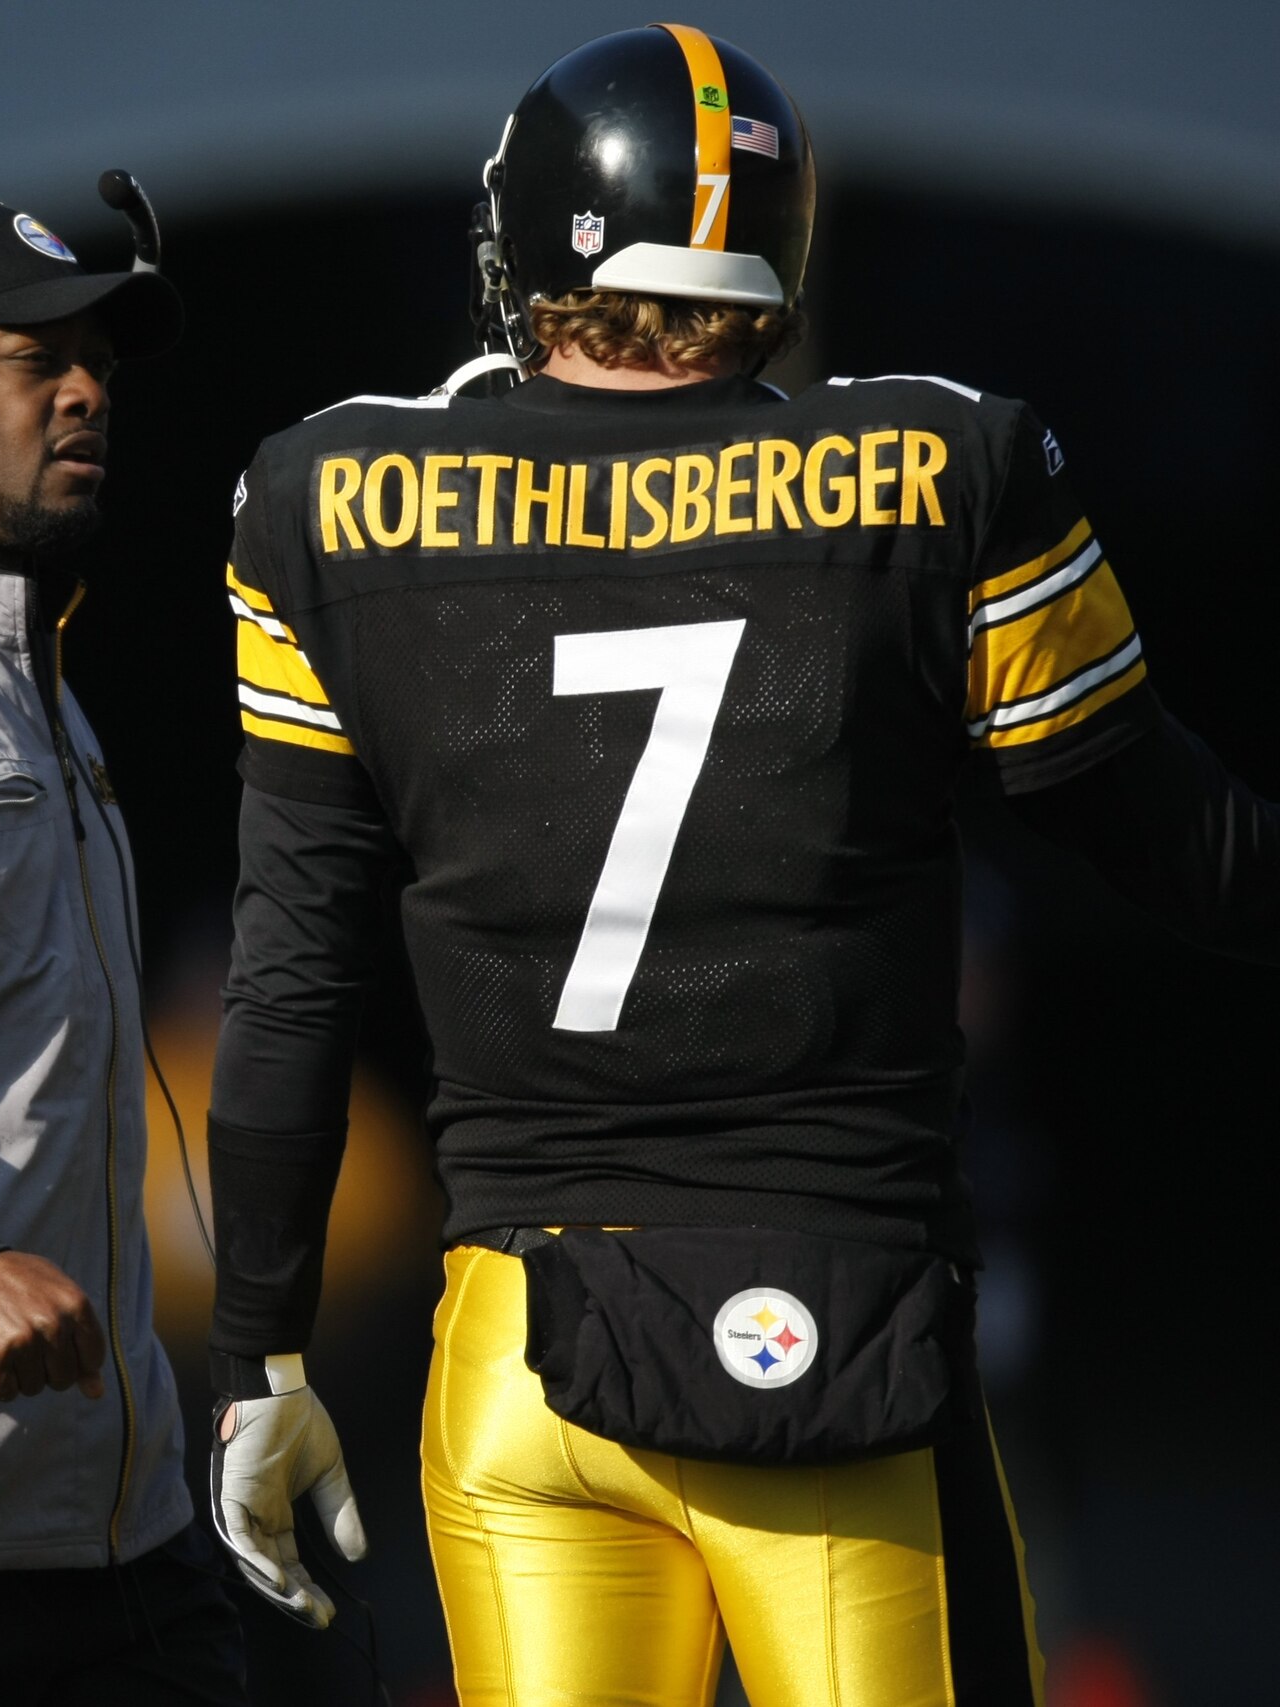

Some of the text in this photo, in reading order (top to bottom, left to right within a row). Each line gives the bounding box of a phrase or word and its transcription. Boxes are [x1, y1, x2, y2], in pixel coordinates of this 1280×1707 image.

[577, 231, 599, 250] NFL
[691, 174, 730, 245] 7
[319, 430, 947, 553] ROETHLISBERGER
[552, 619, 747, 1032] 7
[727, 1329, 762, 1341] Steelers
